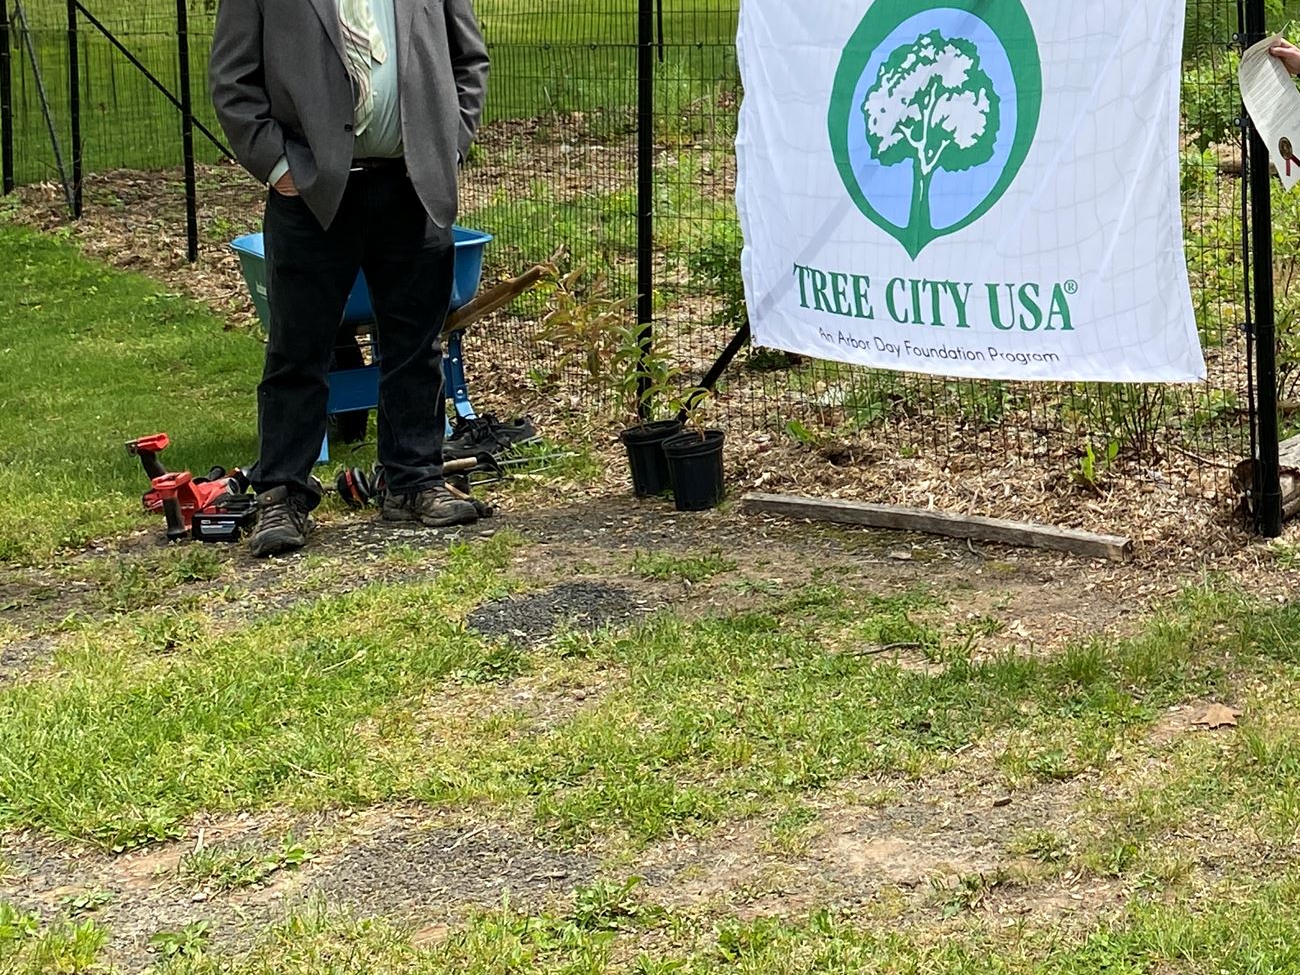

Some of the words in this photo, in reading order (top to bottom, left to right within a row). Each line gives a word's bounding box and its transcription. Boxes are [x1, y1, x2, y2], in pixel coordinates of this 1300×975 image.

[793, 262, 875, 320] TREE
[885, 277, 973, 328] CITY
[819, 327, 835, 343] An
[838, 330, 871, 350] Arbor
[875, 336, 902, 357] Day
[905, 341, 985, 362] Foundation
[988, 347, 1060, 366] Program
